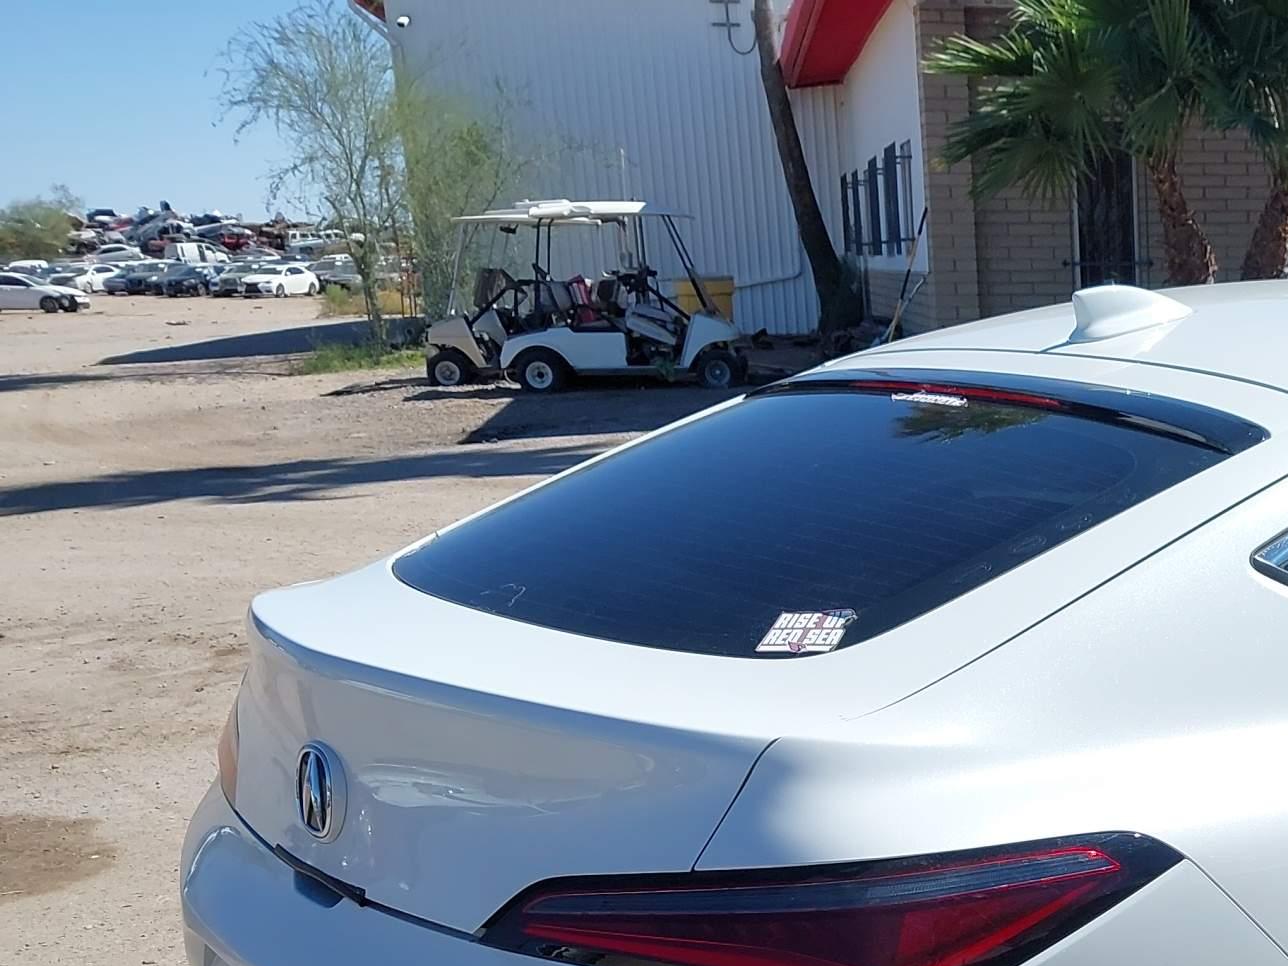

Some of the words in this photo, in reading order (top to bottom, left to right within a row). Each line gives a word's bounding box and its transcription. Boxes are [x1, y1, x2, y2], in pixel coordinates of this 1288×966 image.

[775, 612, 823, 629] RISE
[763, 629, 802, 645] RED
[803, 629, 844, 645] SEA
